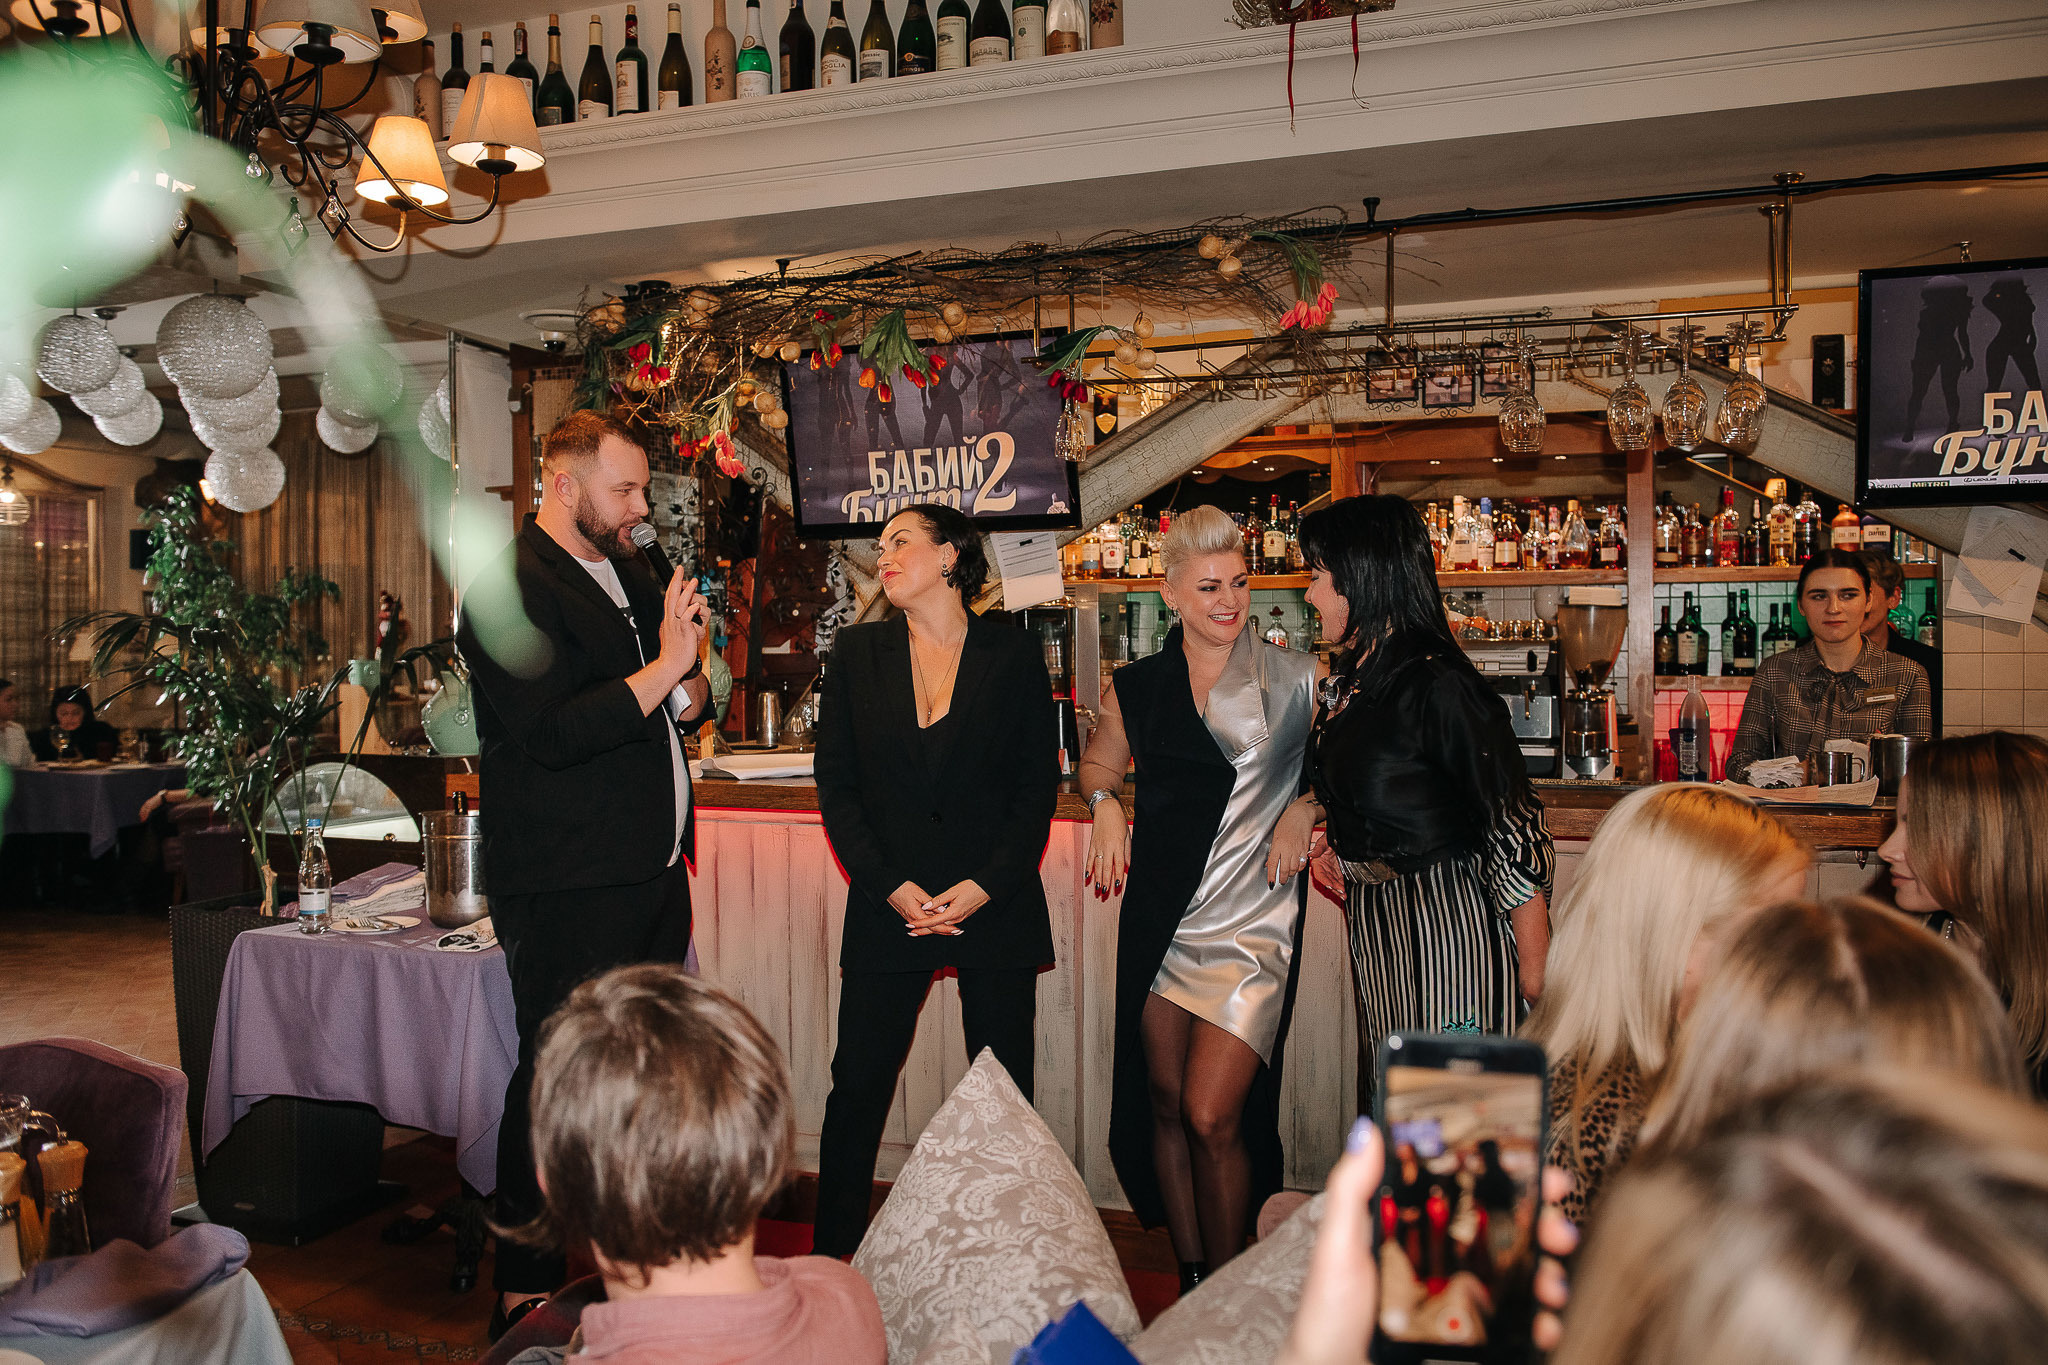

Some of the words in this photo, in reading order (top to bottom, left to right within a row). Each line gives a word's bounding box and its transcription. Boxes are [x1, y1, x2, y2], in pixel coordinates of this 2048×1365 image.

[1983, 390, 2048, 435] БА
[867, 436, 984, 495] БАБИЙ
[973, 431, 1017, 515] 2
[1911, 480, 1949, 488] METRO
